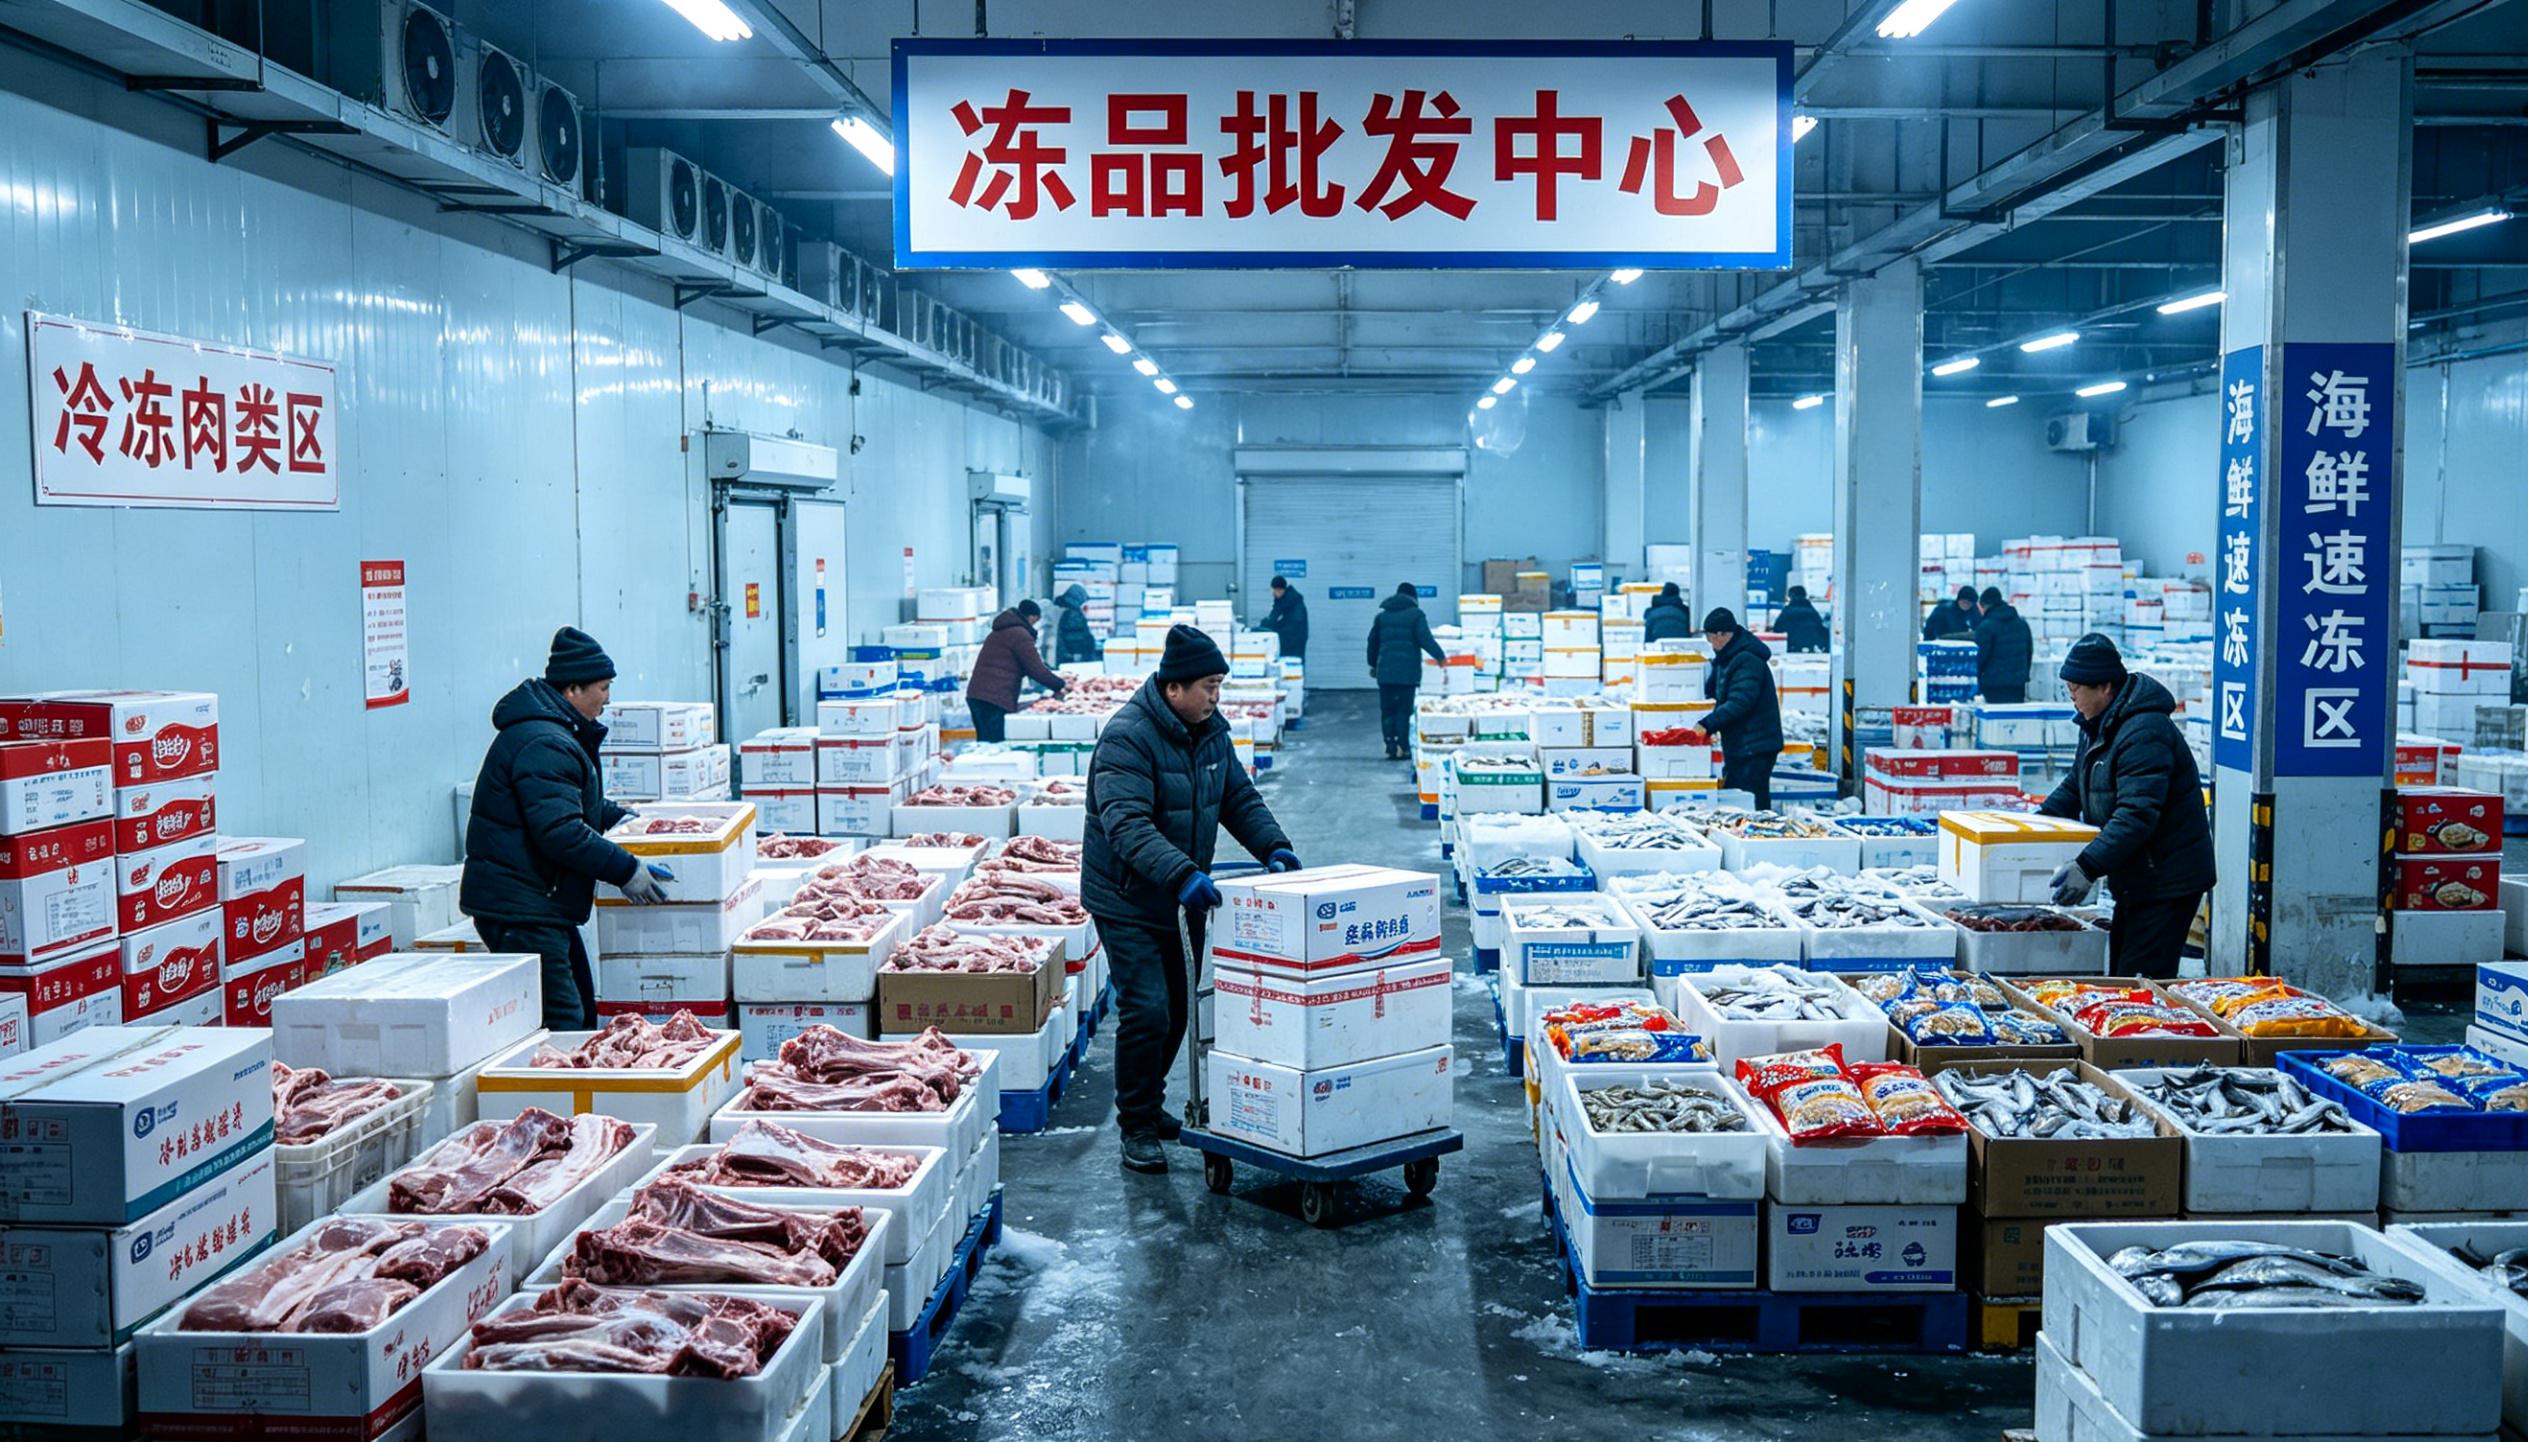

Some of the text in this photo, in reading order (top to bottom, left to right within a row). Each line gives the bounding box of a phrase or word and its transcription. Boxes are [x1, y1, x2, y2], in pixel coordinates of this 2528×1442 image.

[949, 89, 1744, 221] 冻品批发中心
[52, 362, 326, 474] 冷冻肉类区
[2220, 378, 2254, 741] 海鲜速冻区
[2300, 370, 2371, 748] 海鲜速冻区
